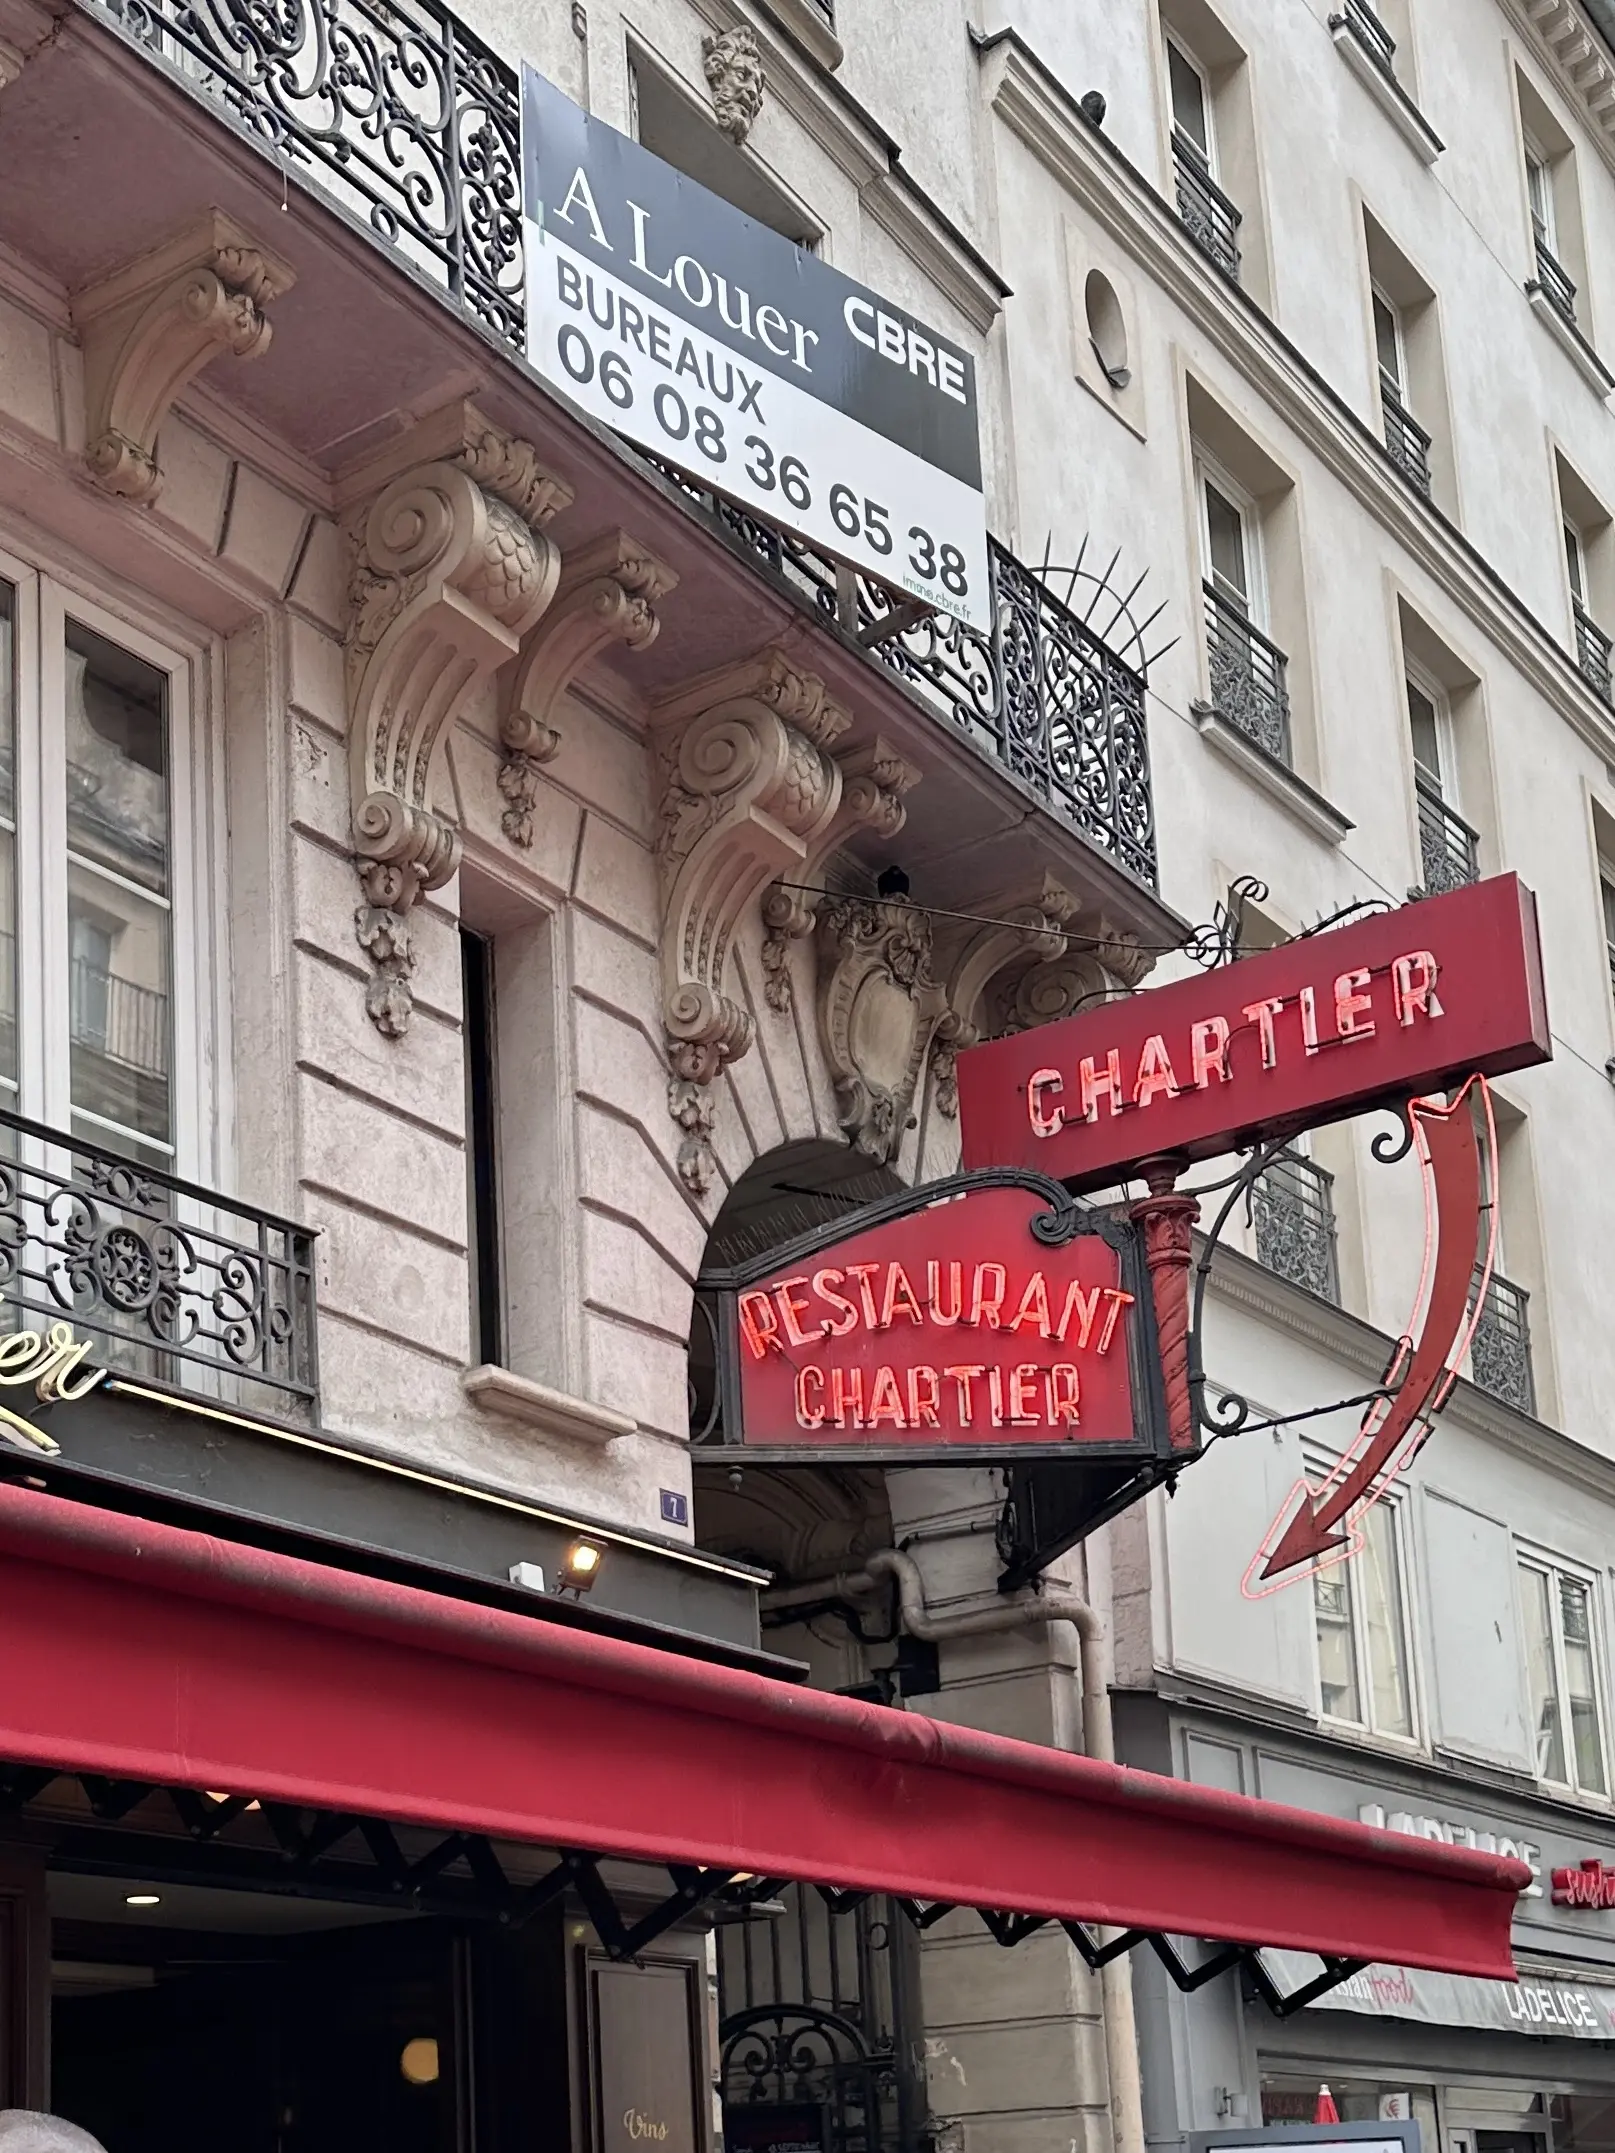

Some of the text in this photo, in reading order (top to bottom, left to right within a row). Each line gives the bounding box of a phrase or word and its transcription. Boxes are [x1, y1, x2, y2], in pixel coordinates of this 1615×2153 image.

[553, 166, 819, 373] A Louer
[556, 255, 766, 427] BUREAUX
[843, 296, 967, 404] CBRE
[557, 324, 968, 597] 06 08 36 65 38
[1028, 950, 1445, 1138] CHARTIER
[738, 1260, 1135, 1360] RESTAURANT
[794, 1363, 1080, 1430] CHARTIER
[1501, 1983, 1598, 2027] LADELICE
[623, 2108, 668, 2140] Vins
